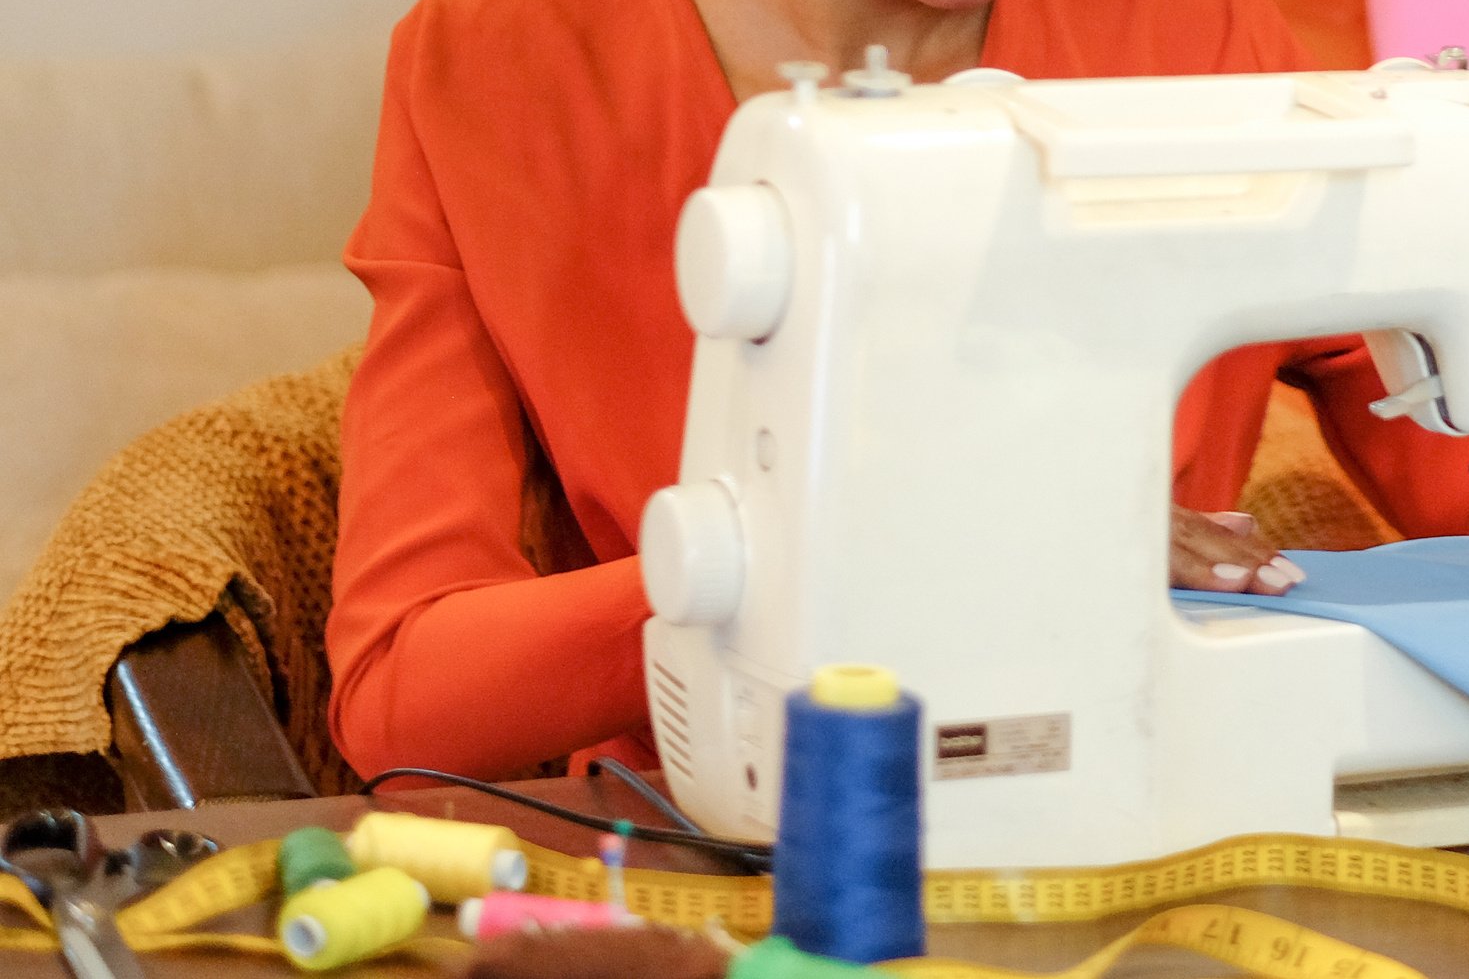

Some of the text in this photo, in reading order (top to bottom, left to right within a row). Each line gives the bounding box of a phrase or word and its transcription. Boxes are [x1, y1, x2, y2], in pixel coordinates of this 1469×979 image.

[1221, 853, 1235, 876] 231
[1242, 849, 1257, 872] 232
[1268, 848, 1284, 871] 233
[1295, 849, 1311, 873] 234
[1321, 852, 1337, 876] 235
[1348, 854, 1363, 879] 236
[1373, 857, 1388, 882] 237
[1421, 865, 1436, 889] 239
[1445, 869, 1459, 894] 240
[936, 885, 952, 908] 219
[963, 885, 980, 908] 220
[991, 885, 1008, 908] 221
[1019, 884, 1036, 907] 222
[1047, 883, 1064, 907] 223
[1074, 882, 1091, 906] 224
[1202, 918, 1241, 946] 17
[1270, 935, 1309, 968] 16
